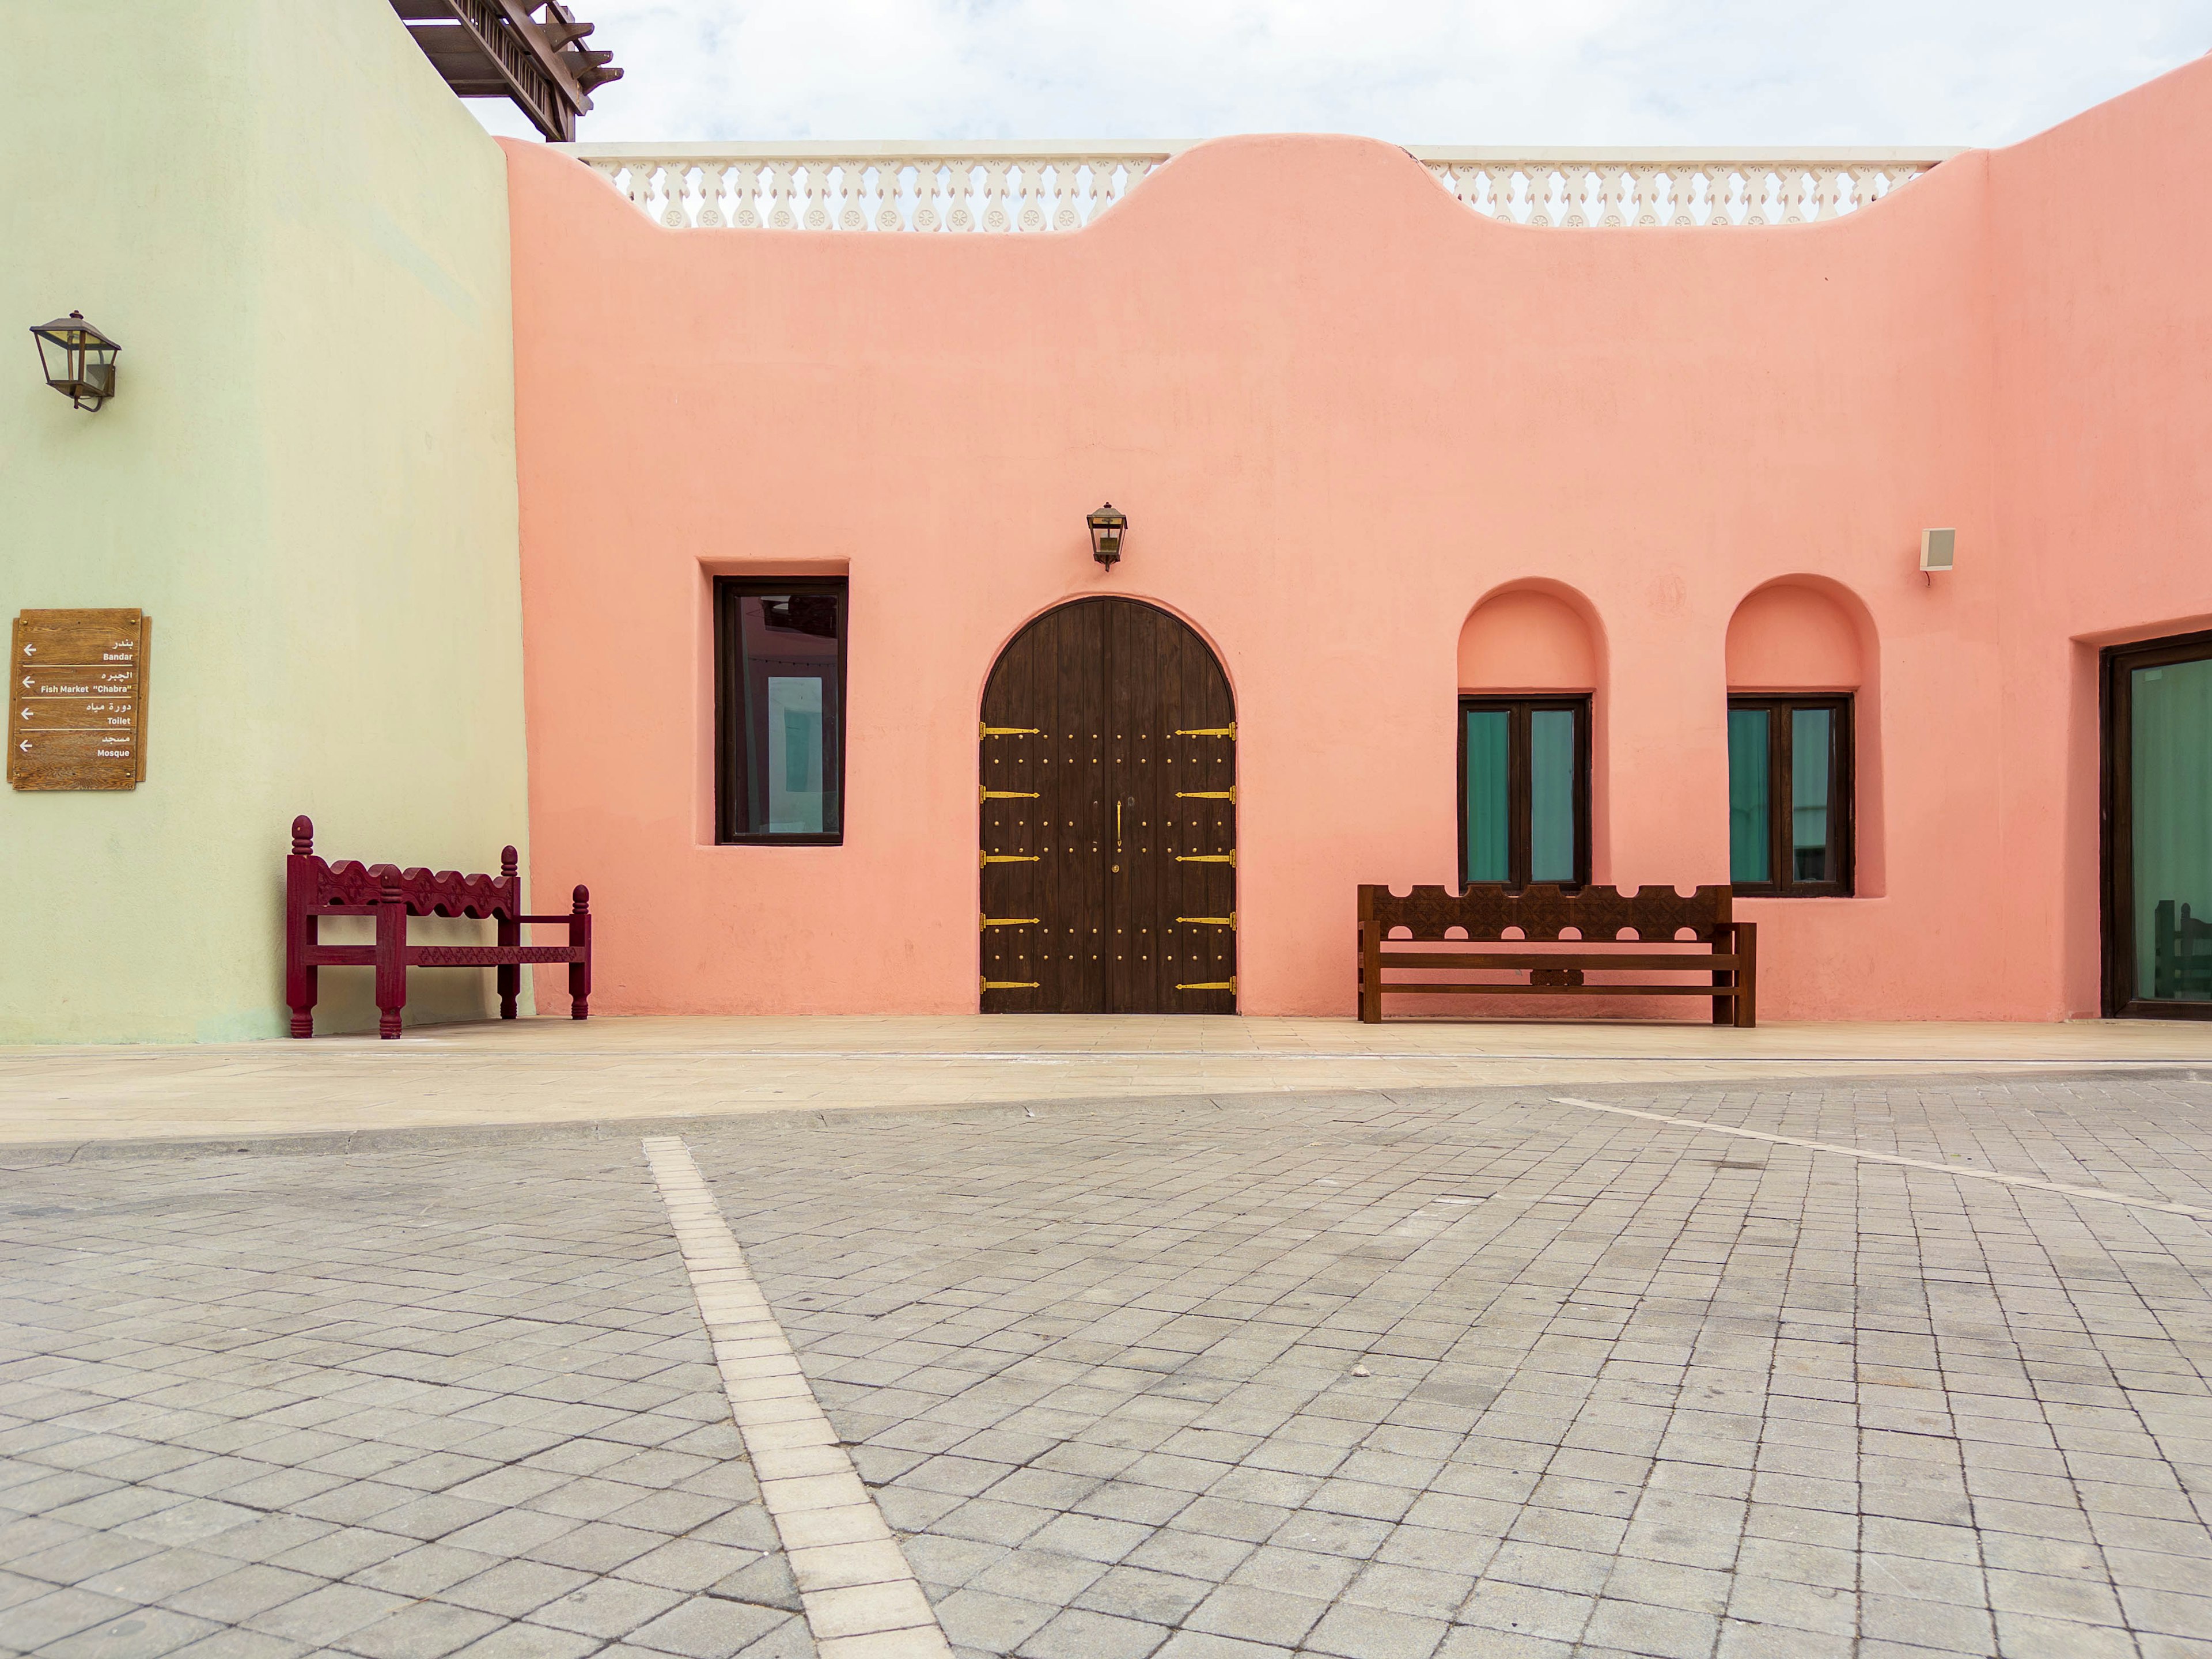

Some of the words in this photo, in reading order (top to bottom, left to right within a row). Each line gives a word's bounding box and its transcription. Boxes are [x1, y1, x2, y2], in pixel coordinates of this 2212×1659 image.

[112, 639, 134, 649] بندر
[86, 702, 105, 713] مياه
[108, 703, 131, 713] دورة
[102, 736, 130, 744] مسجد
[97, 749, 130, 757] Mosque
